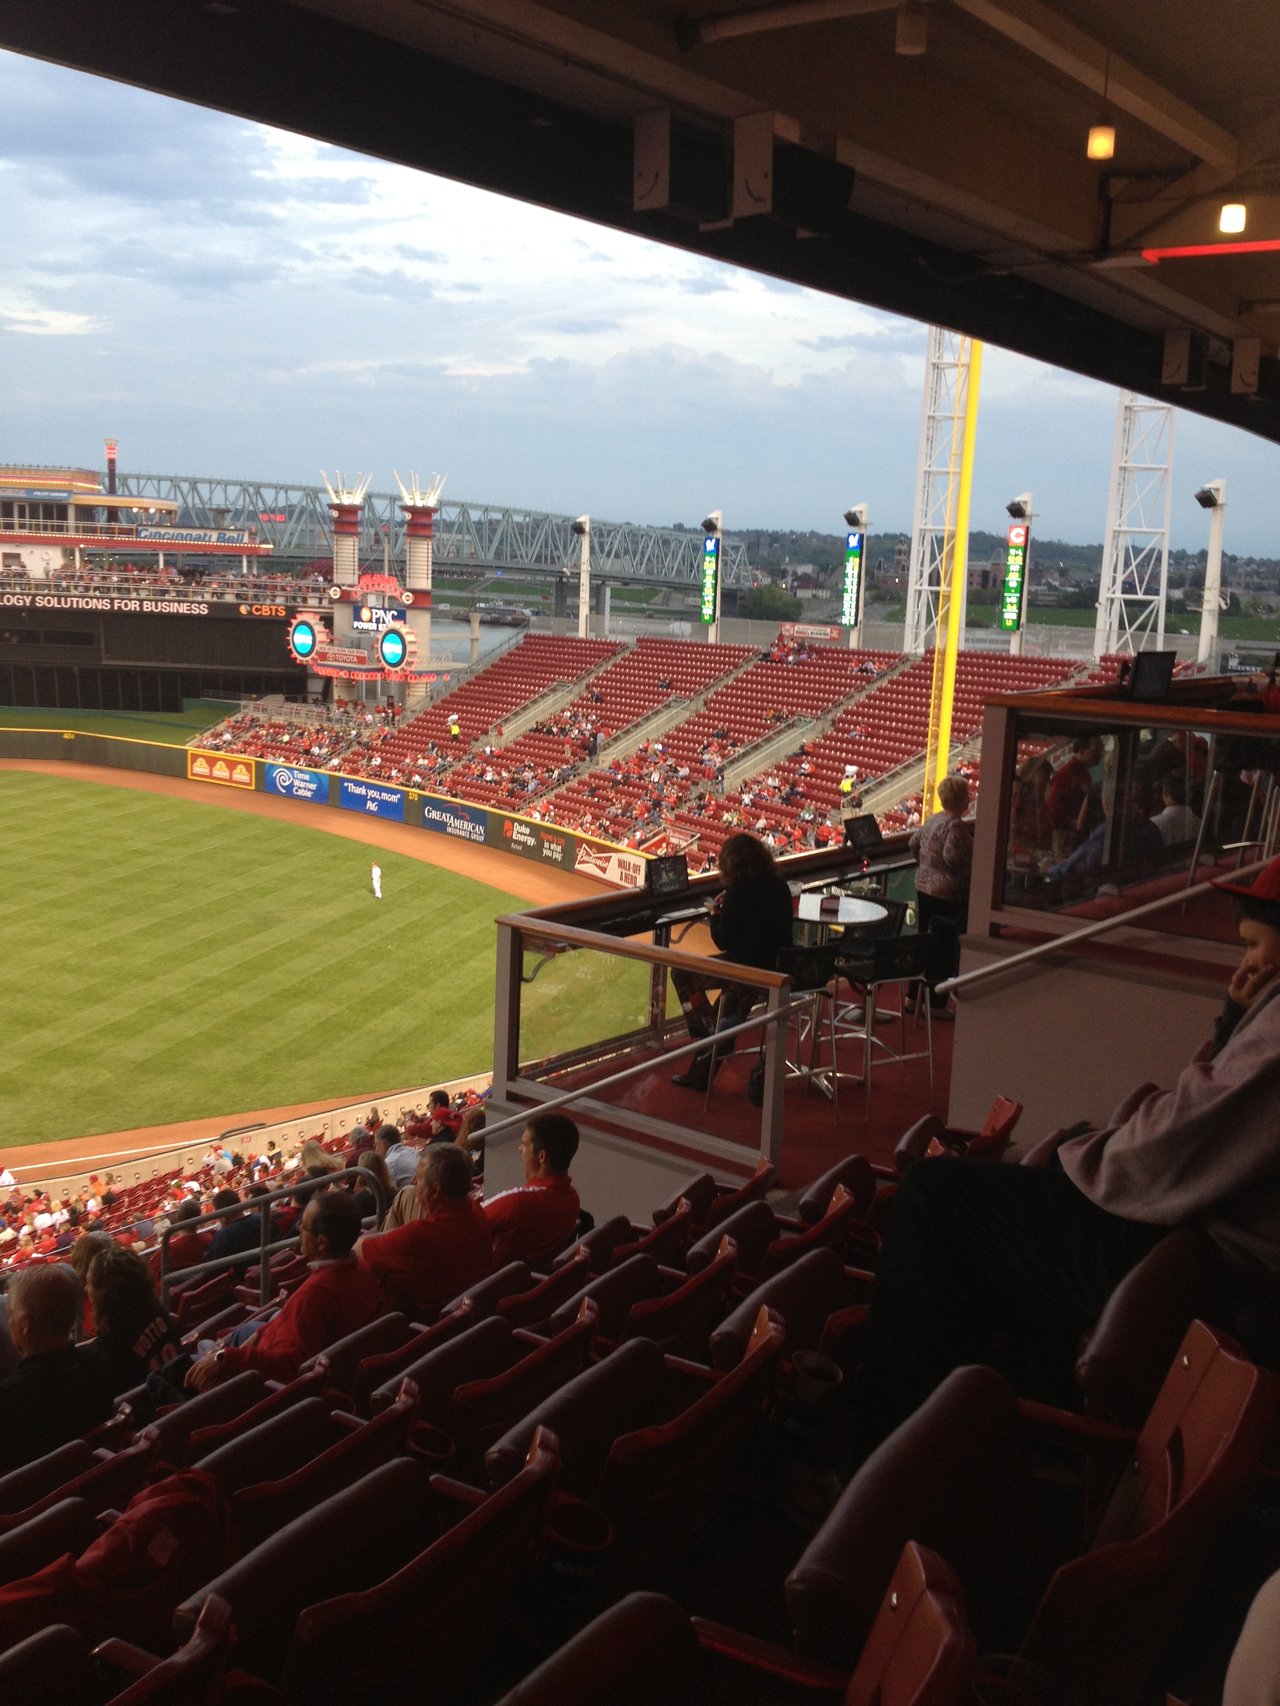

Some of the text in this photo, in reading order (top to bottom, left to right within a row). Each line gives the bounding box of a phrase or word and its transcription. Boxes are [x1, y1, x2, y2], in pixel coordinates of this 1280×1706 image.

[136, 528, 245, 543] Cincinnati Bell
[35, 595, 111, 610] SOLUTIONS
[113, 599, 140, 611] FOR
[142, 600, 209, 615] BUSINESS
[251, 604, 286, 617] CBTS
[371, 608, 398, 625] PNC
[353, 620, 378, 631] POWER
[335, 654, 358, 663] TOYOTA
[293, 770, 310, 780] Time
[294, 779, 317, 790] Warner
[293, 787, 312, 797] Cable
[408, 791, 418, 801] 370
[366, 800, 378, 811] P&G
[446, 826, 485, 842] INSURANCE GROUP
[514, 822, 530, 835] Duke
[542, 848, 552, 857] you
[544, 840, 562, 853] in what
[617, 858, 641, 876] WALK-OFF
[624, 872, 637, 887] HERO
[132, 1316, 167, 1358] VOTTO
